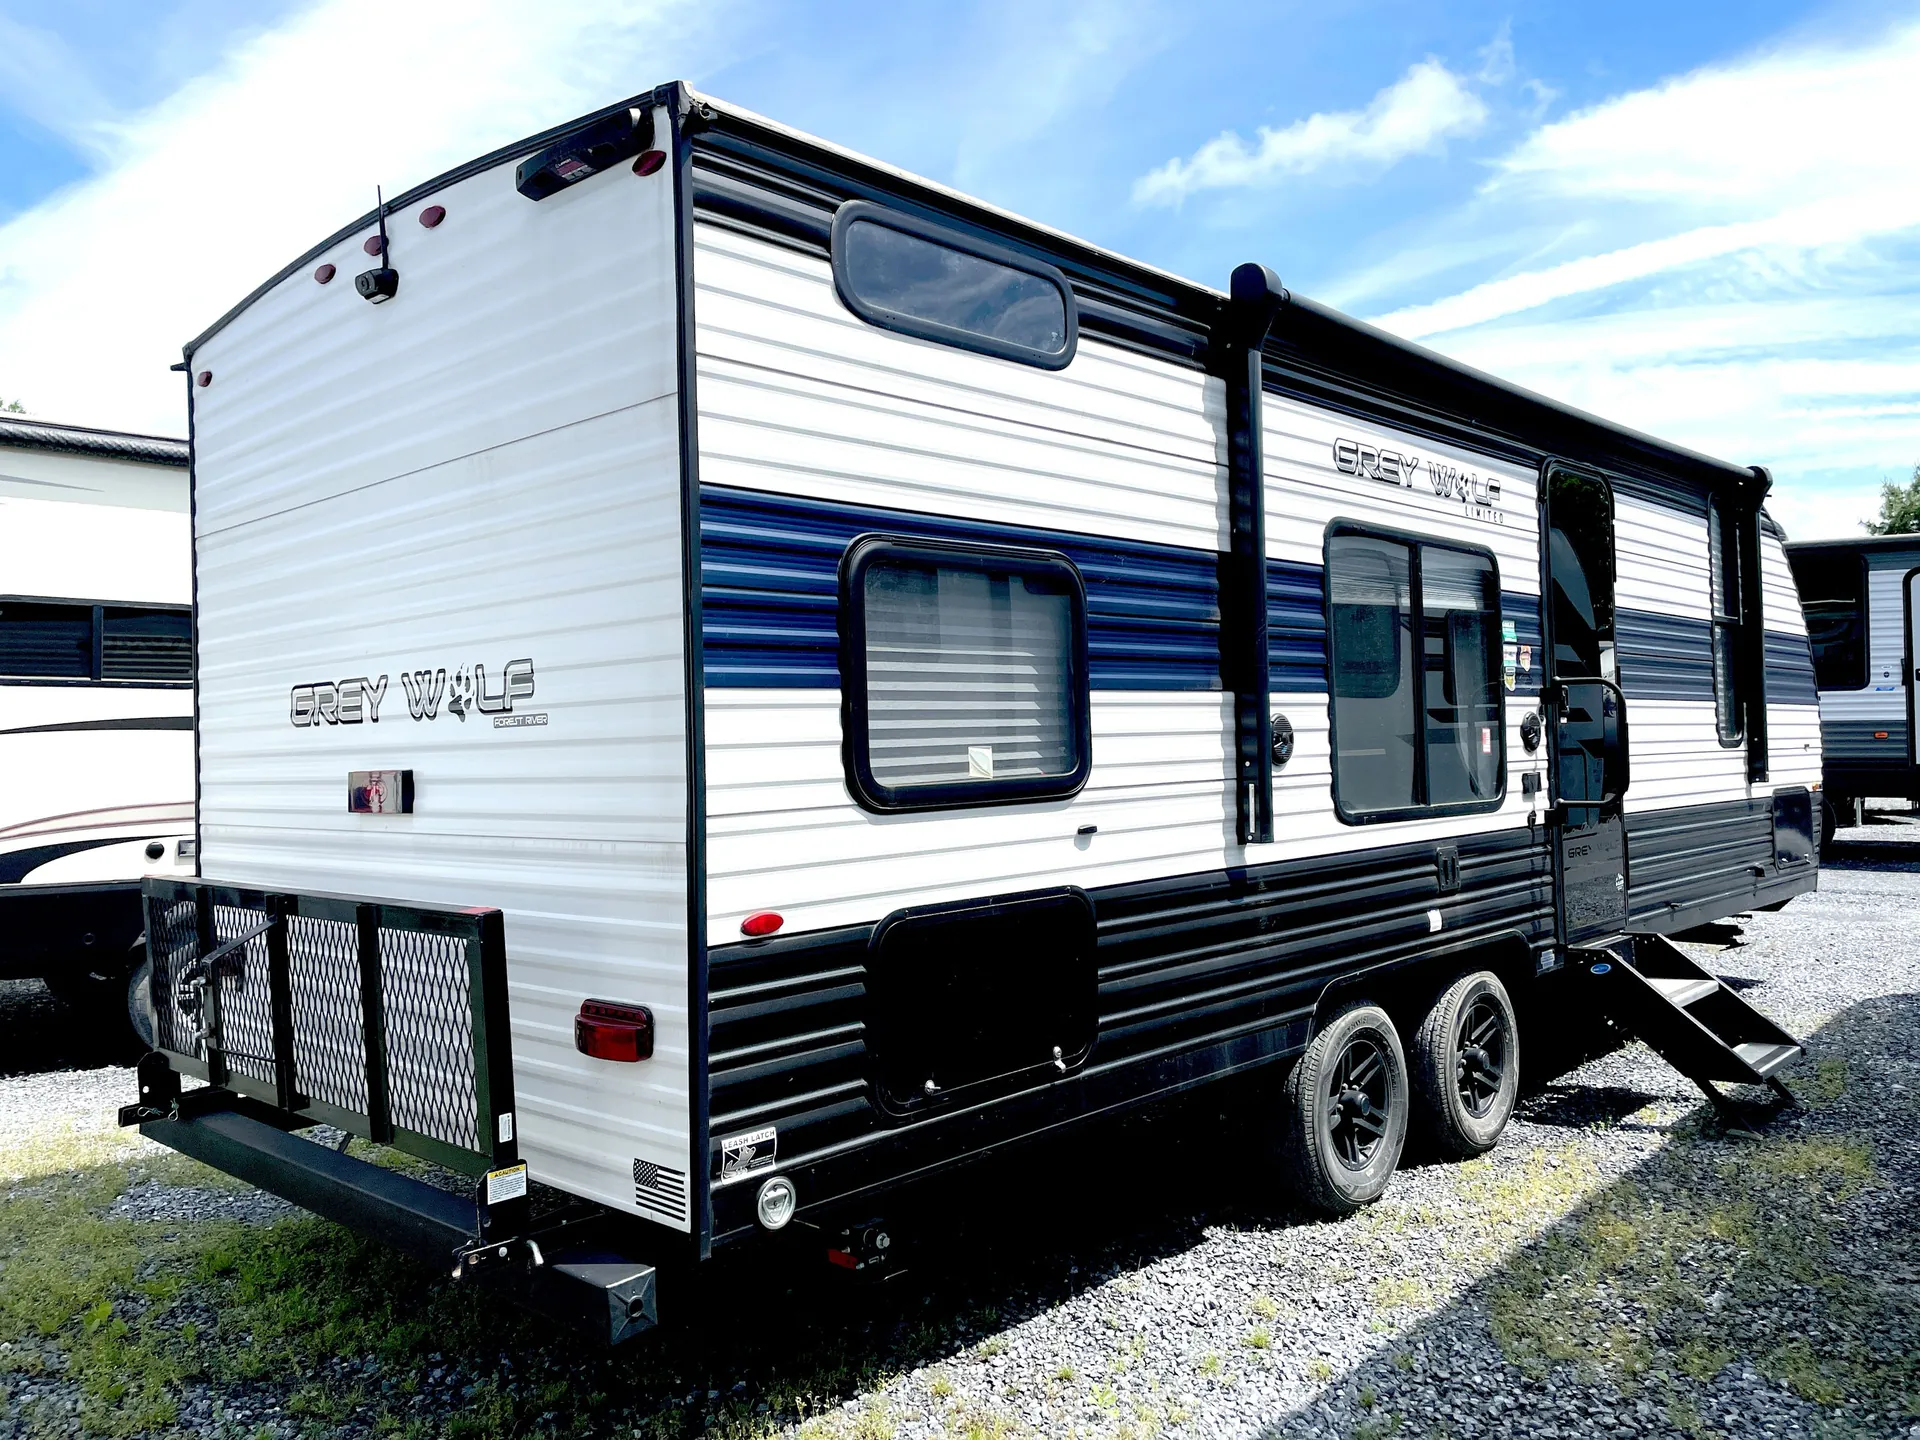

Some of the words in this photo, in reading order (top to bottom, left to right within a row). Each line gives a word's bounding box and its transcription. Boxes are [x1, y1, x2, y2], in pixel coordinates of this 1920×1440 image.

[1332, 437, 1419, 488] GREY
[1465, 506, 1504, 524] LIMITED
[290, 674, 389, 727] GREY
[494, 716, 523, 727] FOREST
[525, 714, 548, 725] RIVER
[723, 1136, 749, 1149] LEASH
[751, 1129, 775, 1142] LATCH
[499, 1166, 520, 1177] CAUTION
